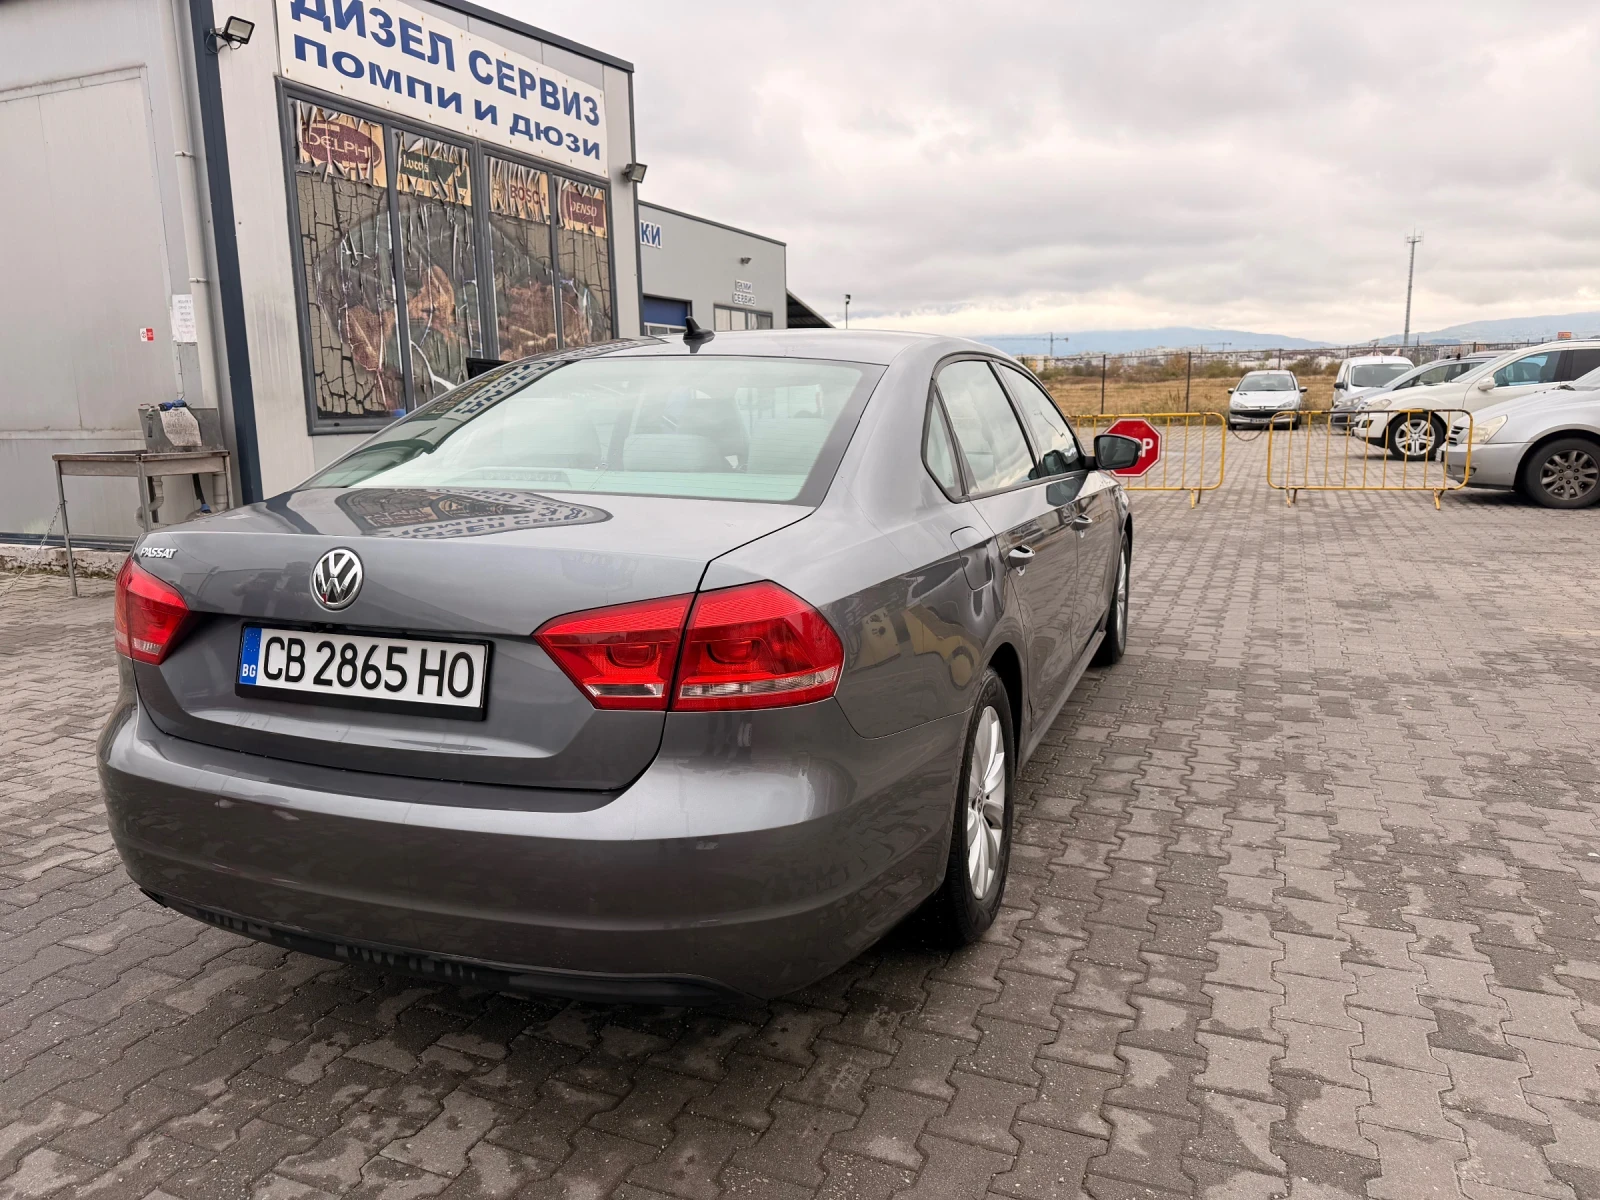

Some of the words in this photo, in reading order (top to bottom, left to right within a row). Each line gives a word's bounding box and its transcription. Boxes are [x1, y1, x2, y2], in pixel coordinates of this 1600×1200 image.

[291, 0, 456, 73] ДИЗЕЛ
[468, 49, 600, 127] СЕРВИЗ
[293, 33, 463, 115] ПОМПИ
[474, 98, 498, 126] И
[509, 112, 601, 161] ДЮЗИ
[304, 131, 372, 158] DELPHI
[510, 183, 547, 207] BOSCH
[140, 547, 178, 559] PASSAT
[242, 663, 257, 678] BG
[263, 636, 306, 683] CB
[312, 640, 408, 693] 2865
